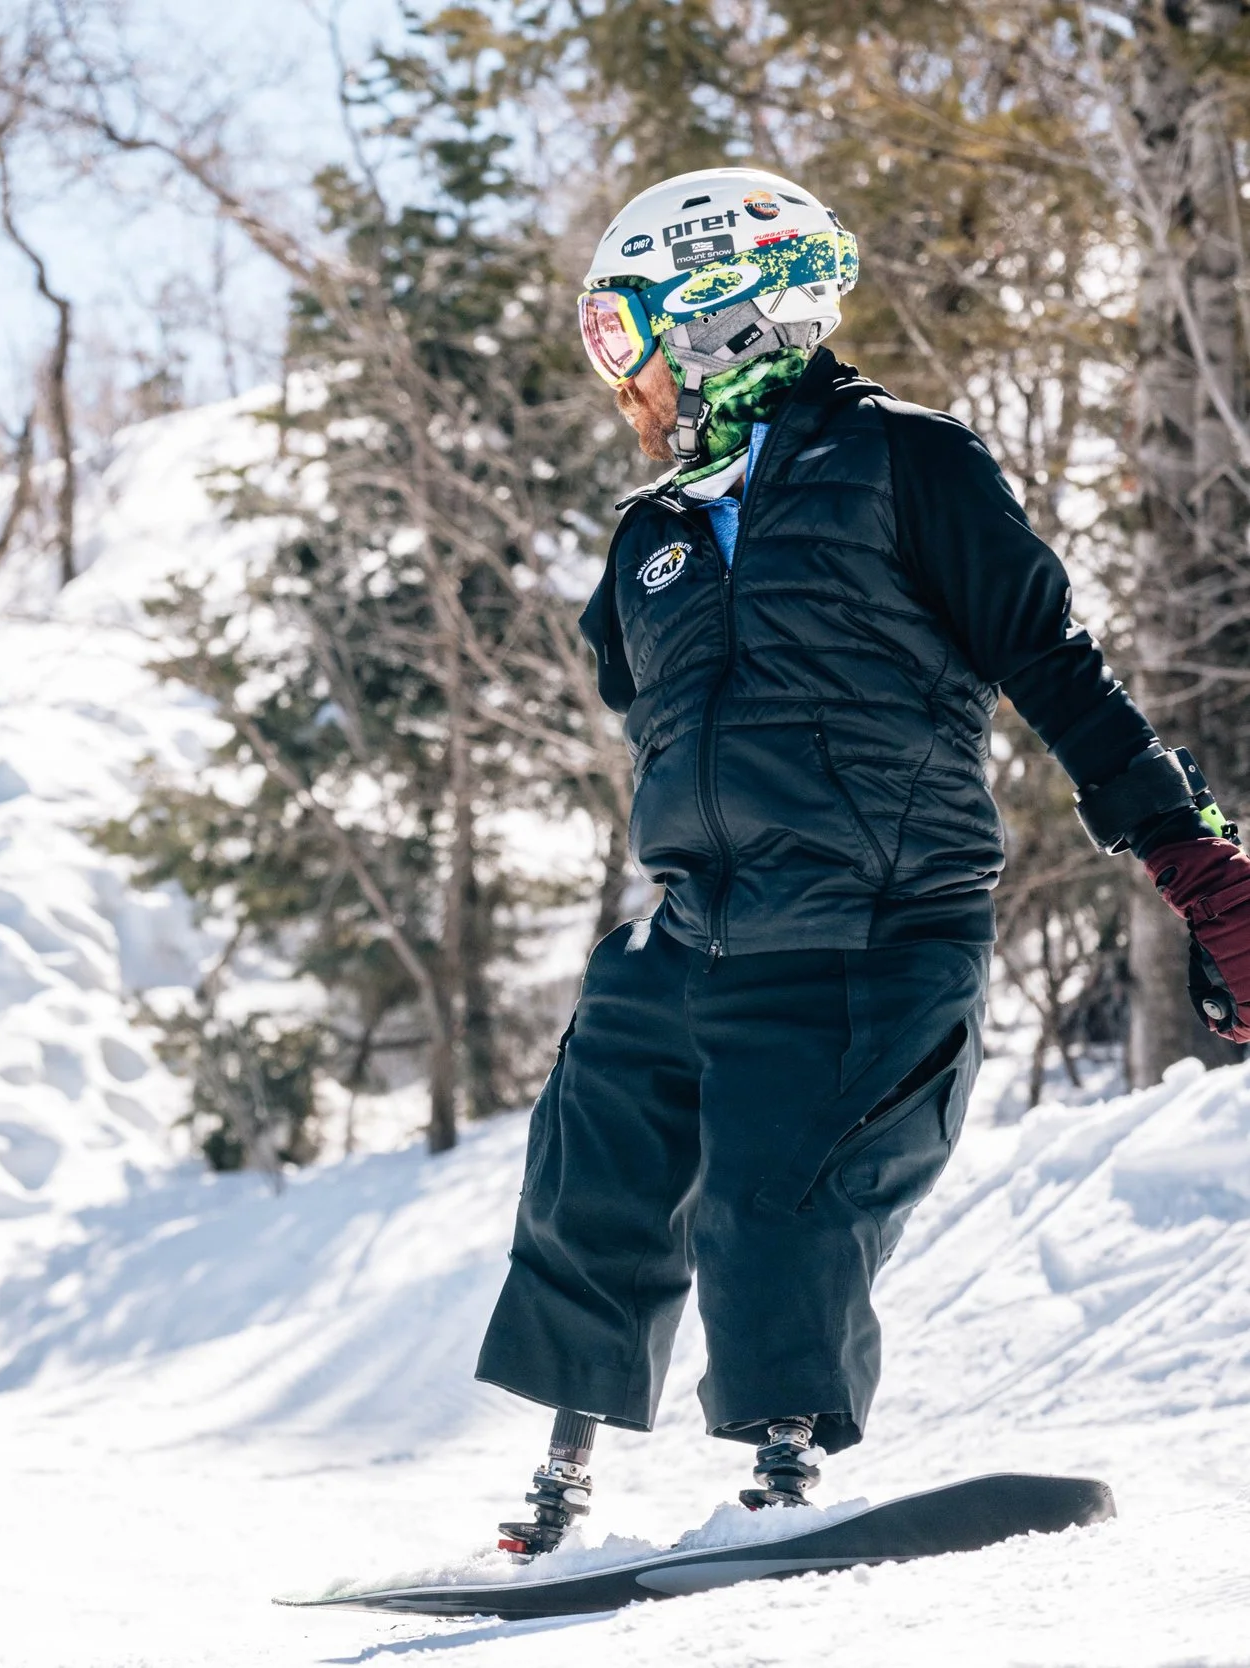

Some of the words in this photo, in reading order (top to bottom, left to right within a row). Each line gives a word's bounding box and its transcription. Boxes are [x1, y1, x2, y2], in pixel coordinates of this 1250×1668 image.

[662, 210, 740, 248] pret
[753, 228, 799, 240] PURGATORY
[623, 243, 632, 254] YA
[632, 237, 650, 250] DIG?
[676, 252, 706, 264] mount
[707, 249, 732, 258] snow
[647, 553, 682, 583] CAF
